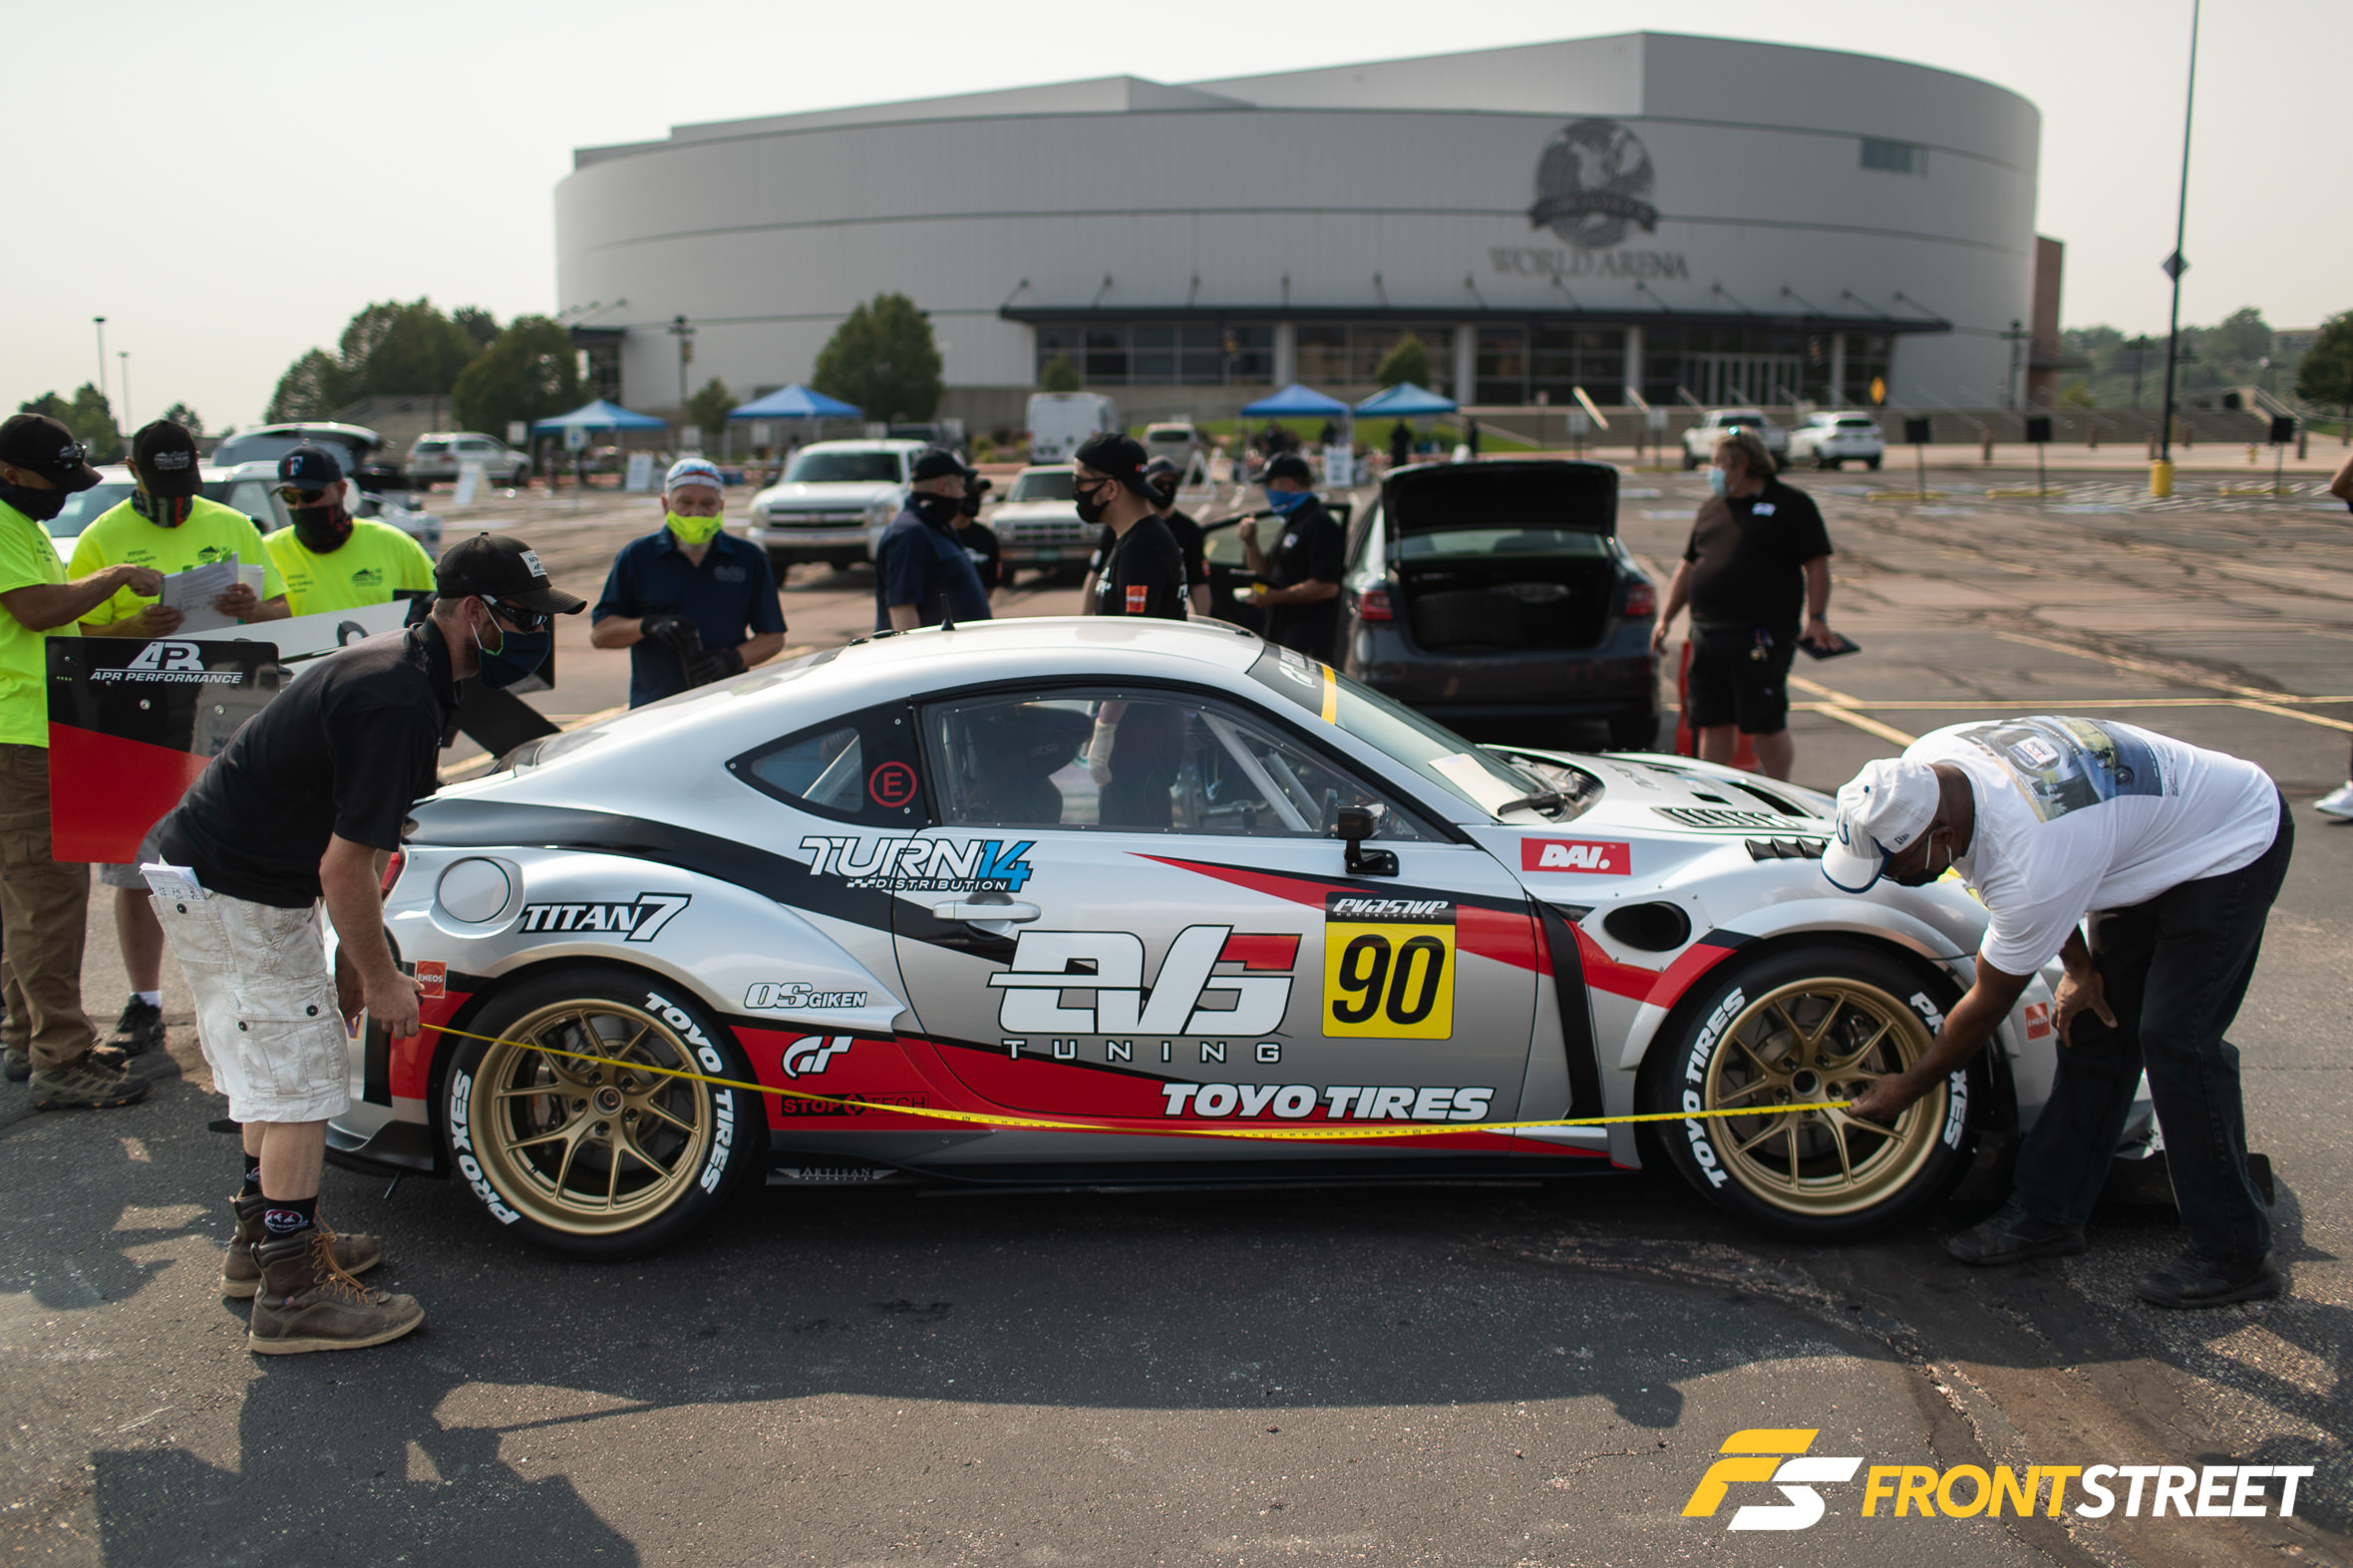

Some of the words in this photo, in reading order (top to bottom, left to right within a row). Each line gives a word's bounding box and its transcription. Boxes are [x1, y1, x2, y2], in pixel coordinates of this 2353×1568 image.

[1489, 248, 1593, 277] WORLD
[1597, 250, 1690, 280] ARENA
[90, 671, 122, 681] APR
[125, 672, 243, 684] PERFORMANCE
[883, 772, 903, 796] E
[874, 877, 1007, 892] DISTRIBUTION
[418, 973, 444, 983] ENEOS
[1332, 934, 1446, 1025] 90
[1000, 1038, 1282, 1064] TUNING
[1685, 987, 1745, 1084] TIRES
[645, 992, 723, 1073] TOYO
[700, 1089, 734, 1194] TIRES
[1161, 1083, 1318, 1118] TOYO
[1323, 1085, 1496, 1120] TIRES
[1683, 1089, 1728, 1188] TOYO
